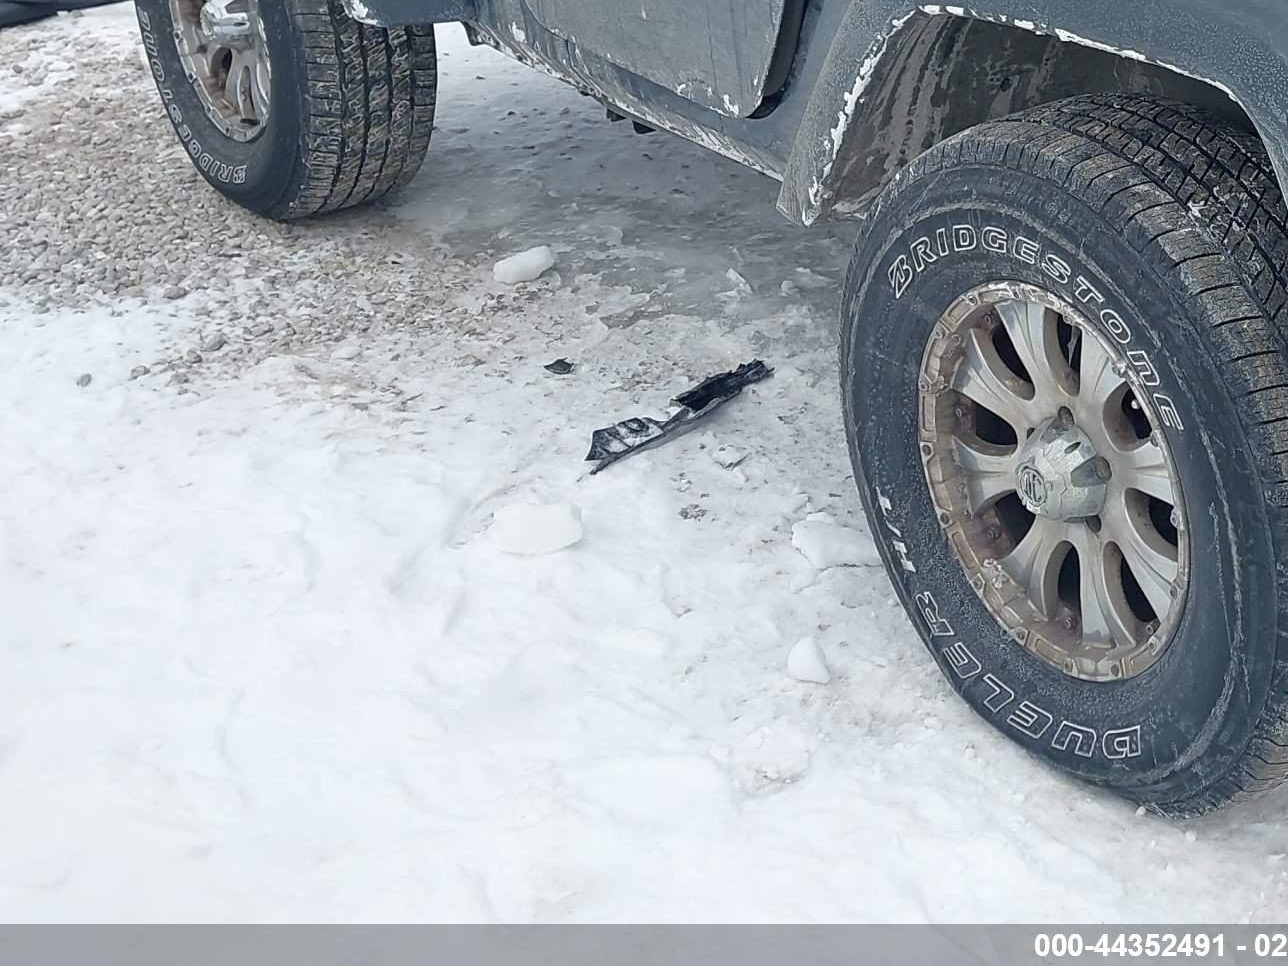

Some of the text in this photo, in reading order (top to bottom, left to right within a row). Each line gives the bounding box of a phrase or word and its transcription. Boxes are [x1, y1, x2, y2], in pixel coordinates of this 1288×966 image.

[137, 6, 248, 184] BRIDGESTONE
[887, 224, 1184, 432] BRIDGESTONE
[915, 591, 1142, 759] DUELER
